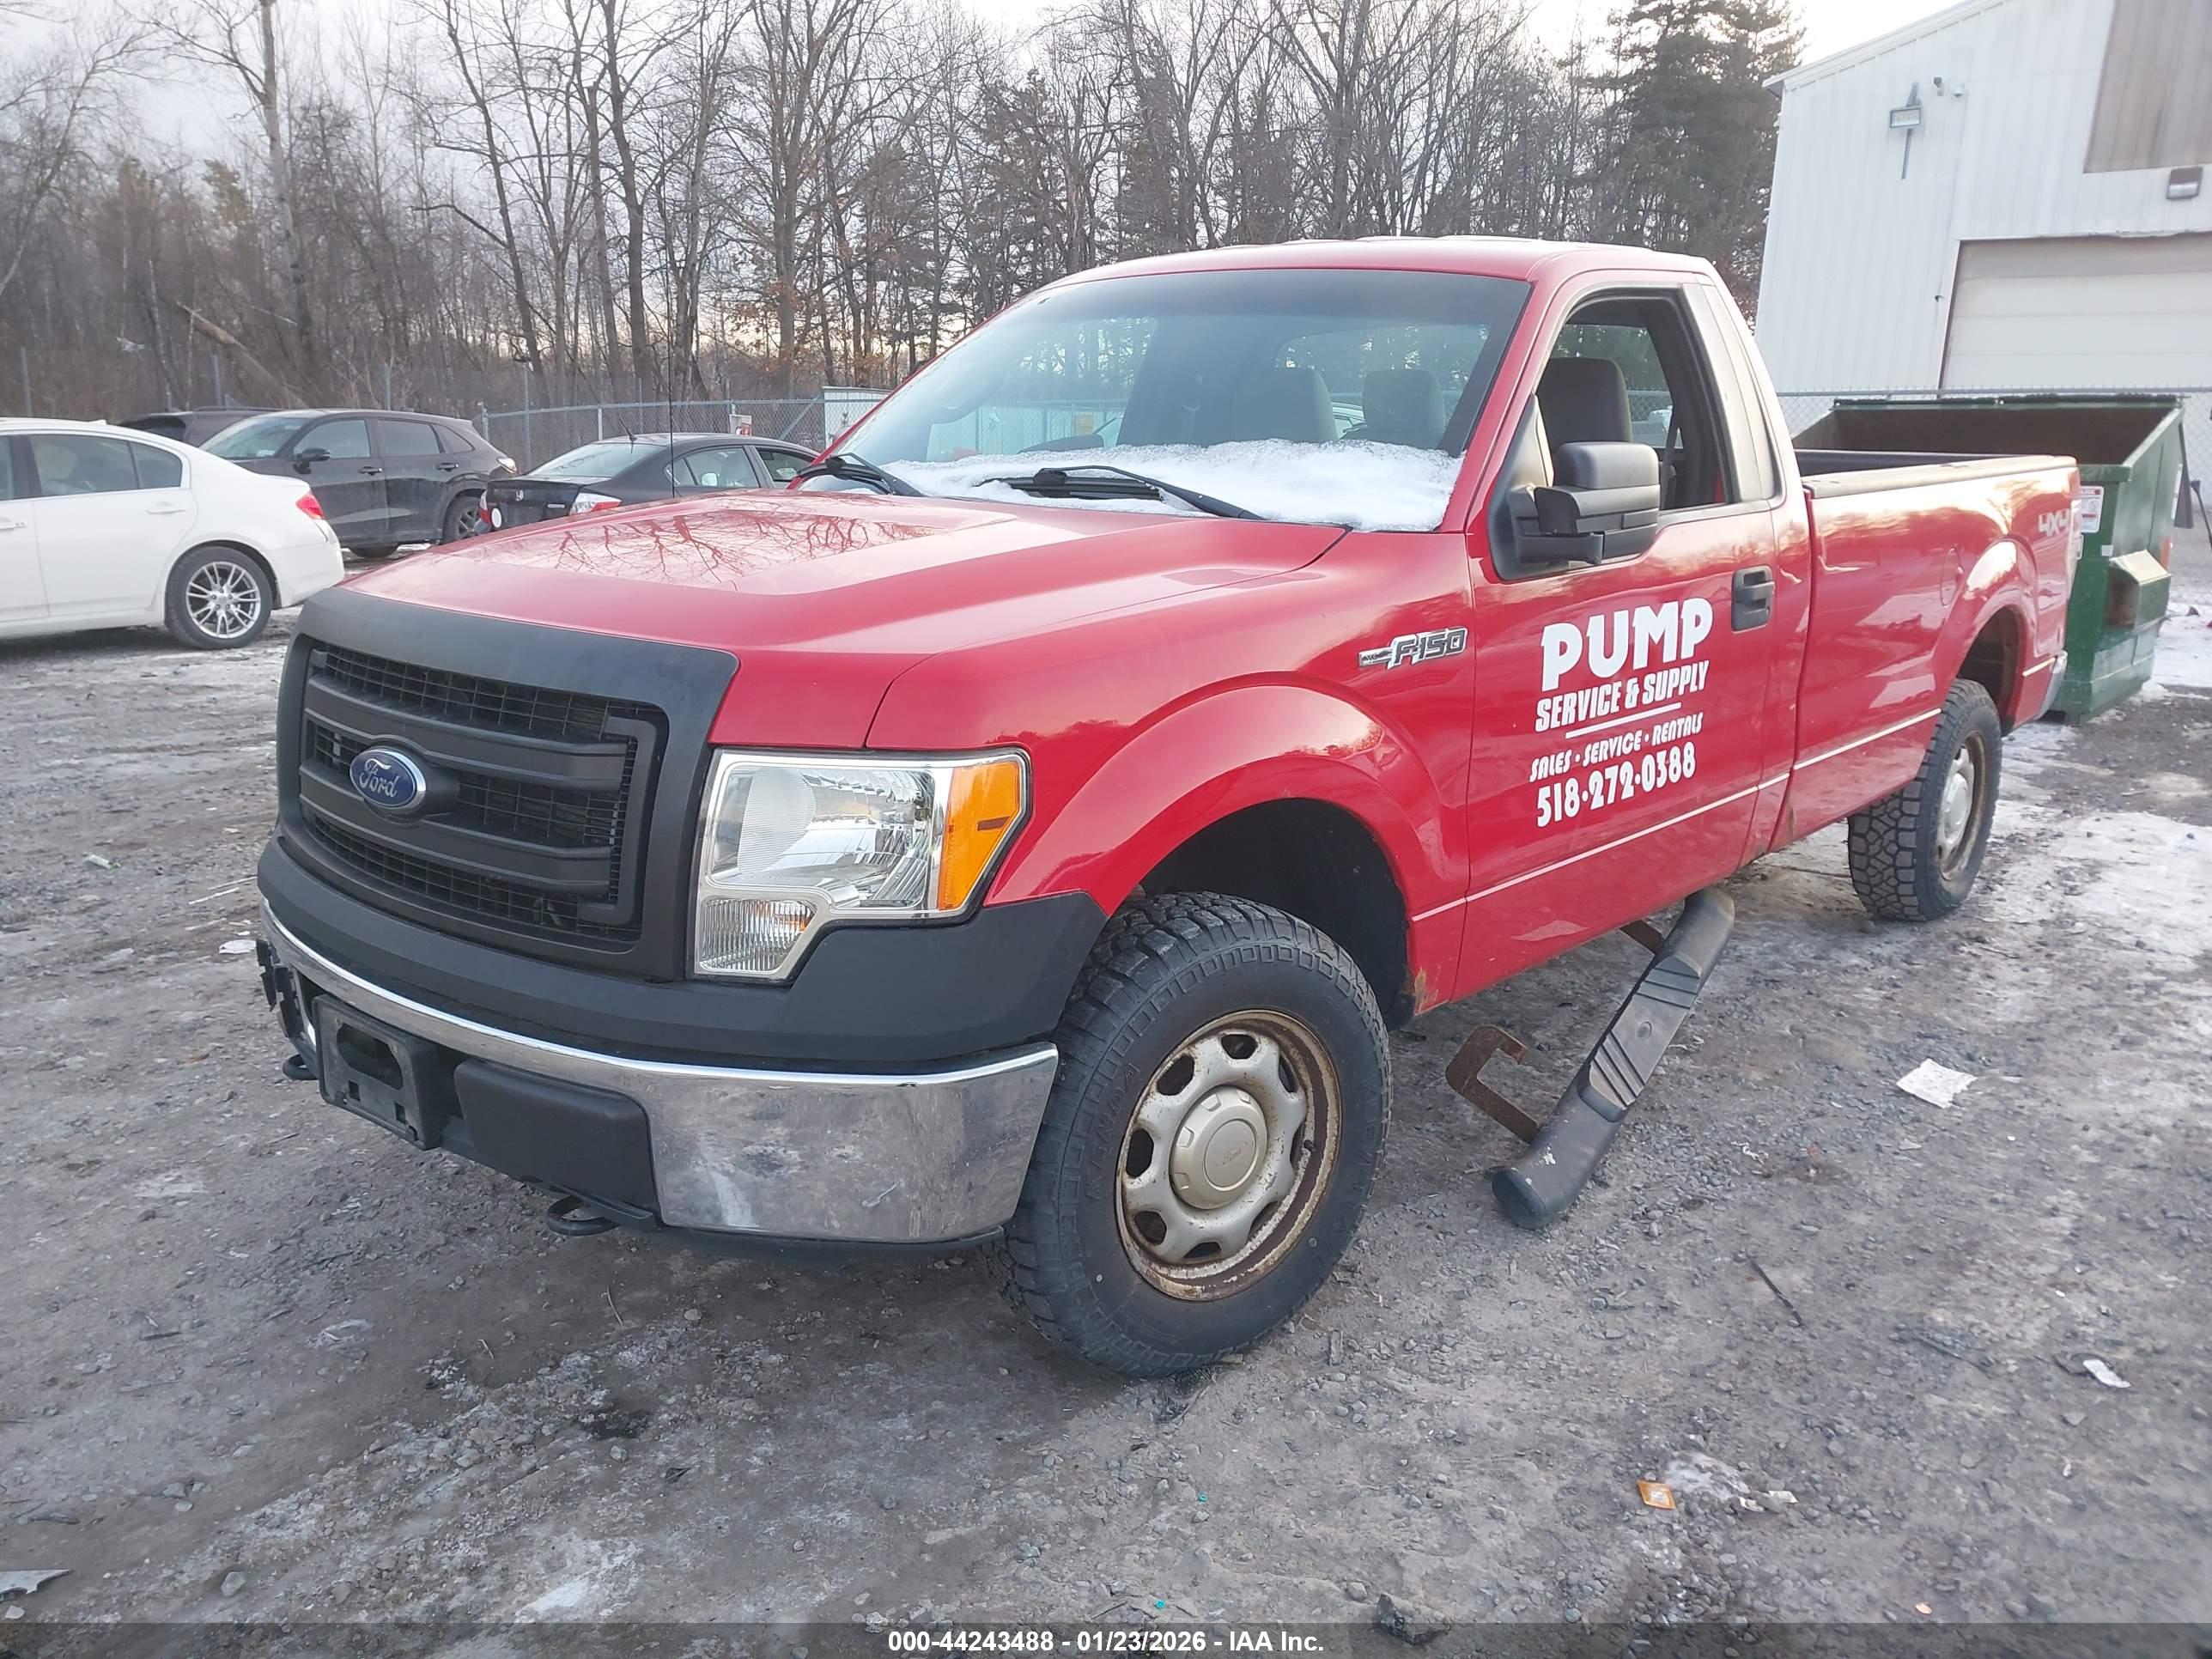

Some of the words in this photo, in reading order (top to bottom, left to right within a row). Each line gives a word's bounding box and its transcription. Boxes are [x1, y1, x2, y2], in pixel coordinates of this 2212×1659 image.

[1540, 598, 1713, 692] PUMP
[1534, 681, 1622, 732] SERVICE
[1624, 677, 1640, 709] &
[1642, 659, 1710, 705] SUPPLY
[359, 758, 400, 798] Ford
[1528, 750, 1572, 782] SALES
[1583, 730, 1643, 767] SERVICE
[1651, 712, 1704, 746] RENTALS
